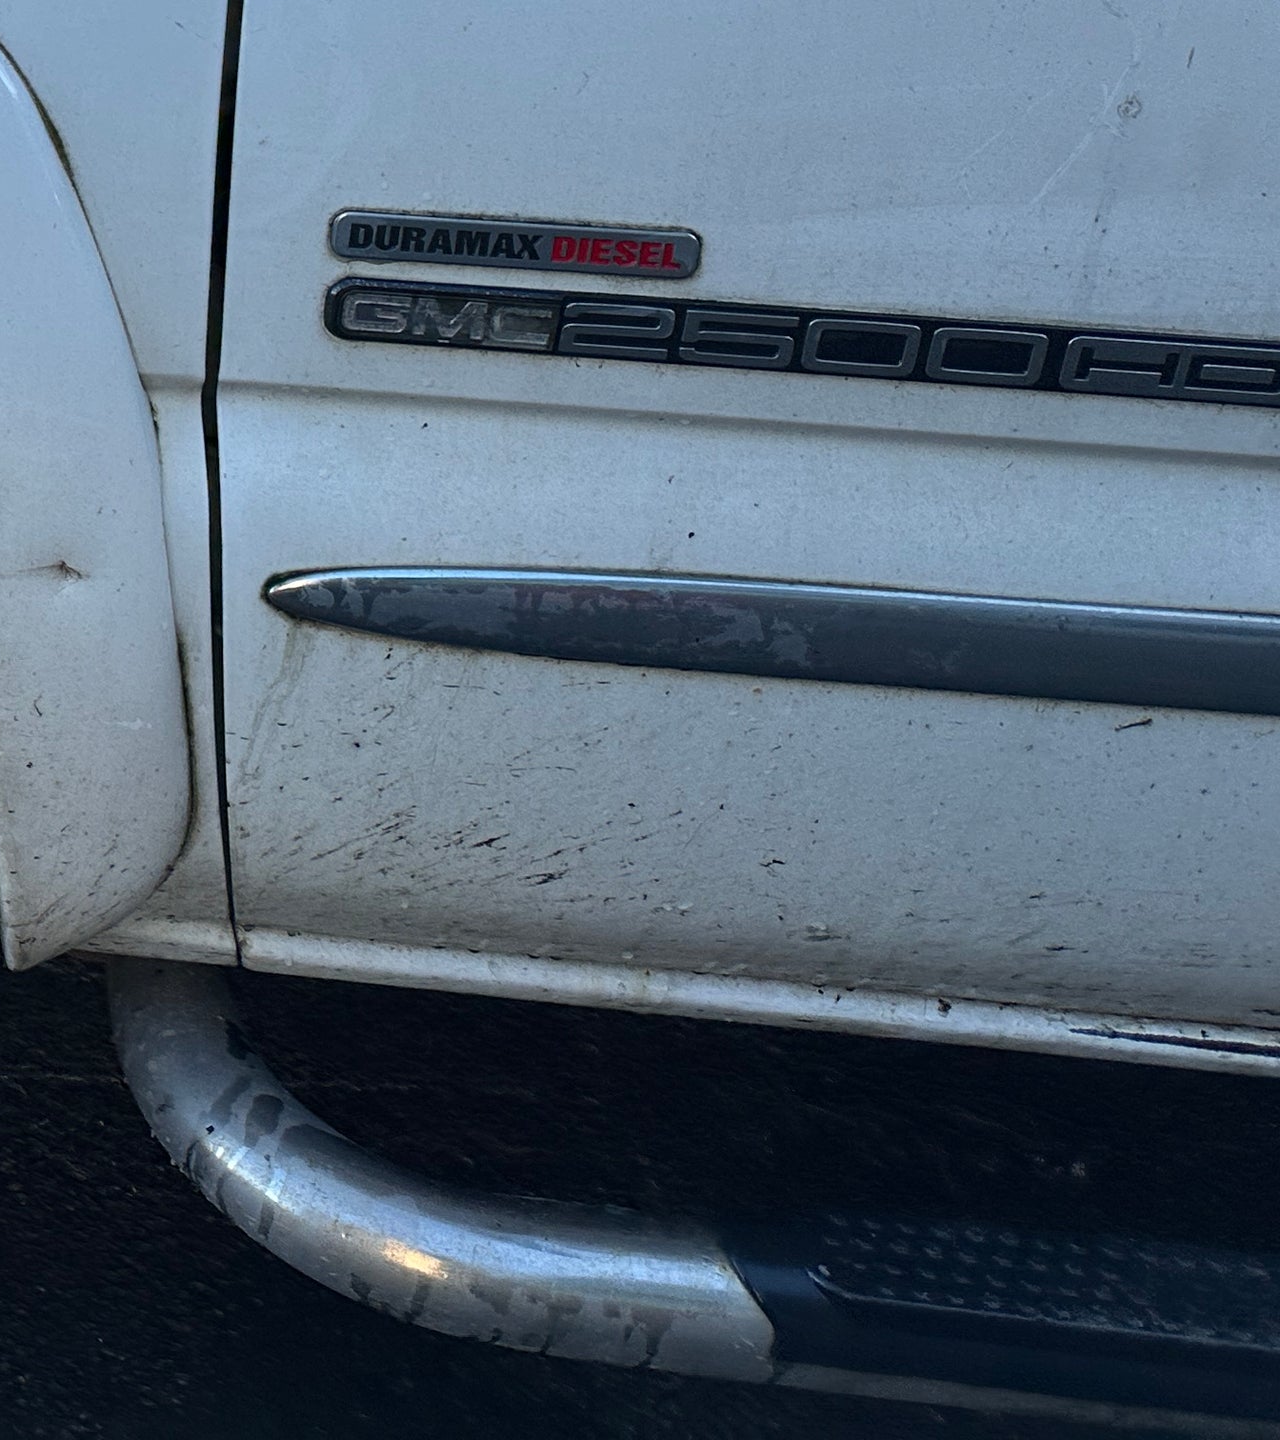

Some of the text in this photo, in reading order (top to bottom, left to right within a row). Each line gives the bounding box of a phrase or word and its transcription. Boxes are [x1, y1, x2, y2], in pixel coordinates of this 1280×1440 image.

[348, 222, 682, 271] DURAMAX DIESEL
[341, 291, 554, 348] GMC
